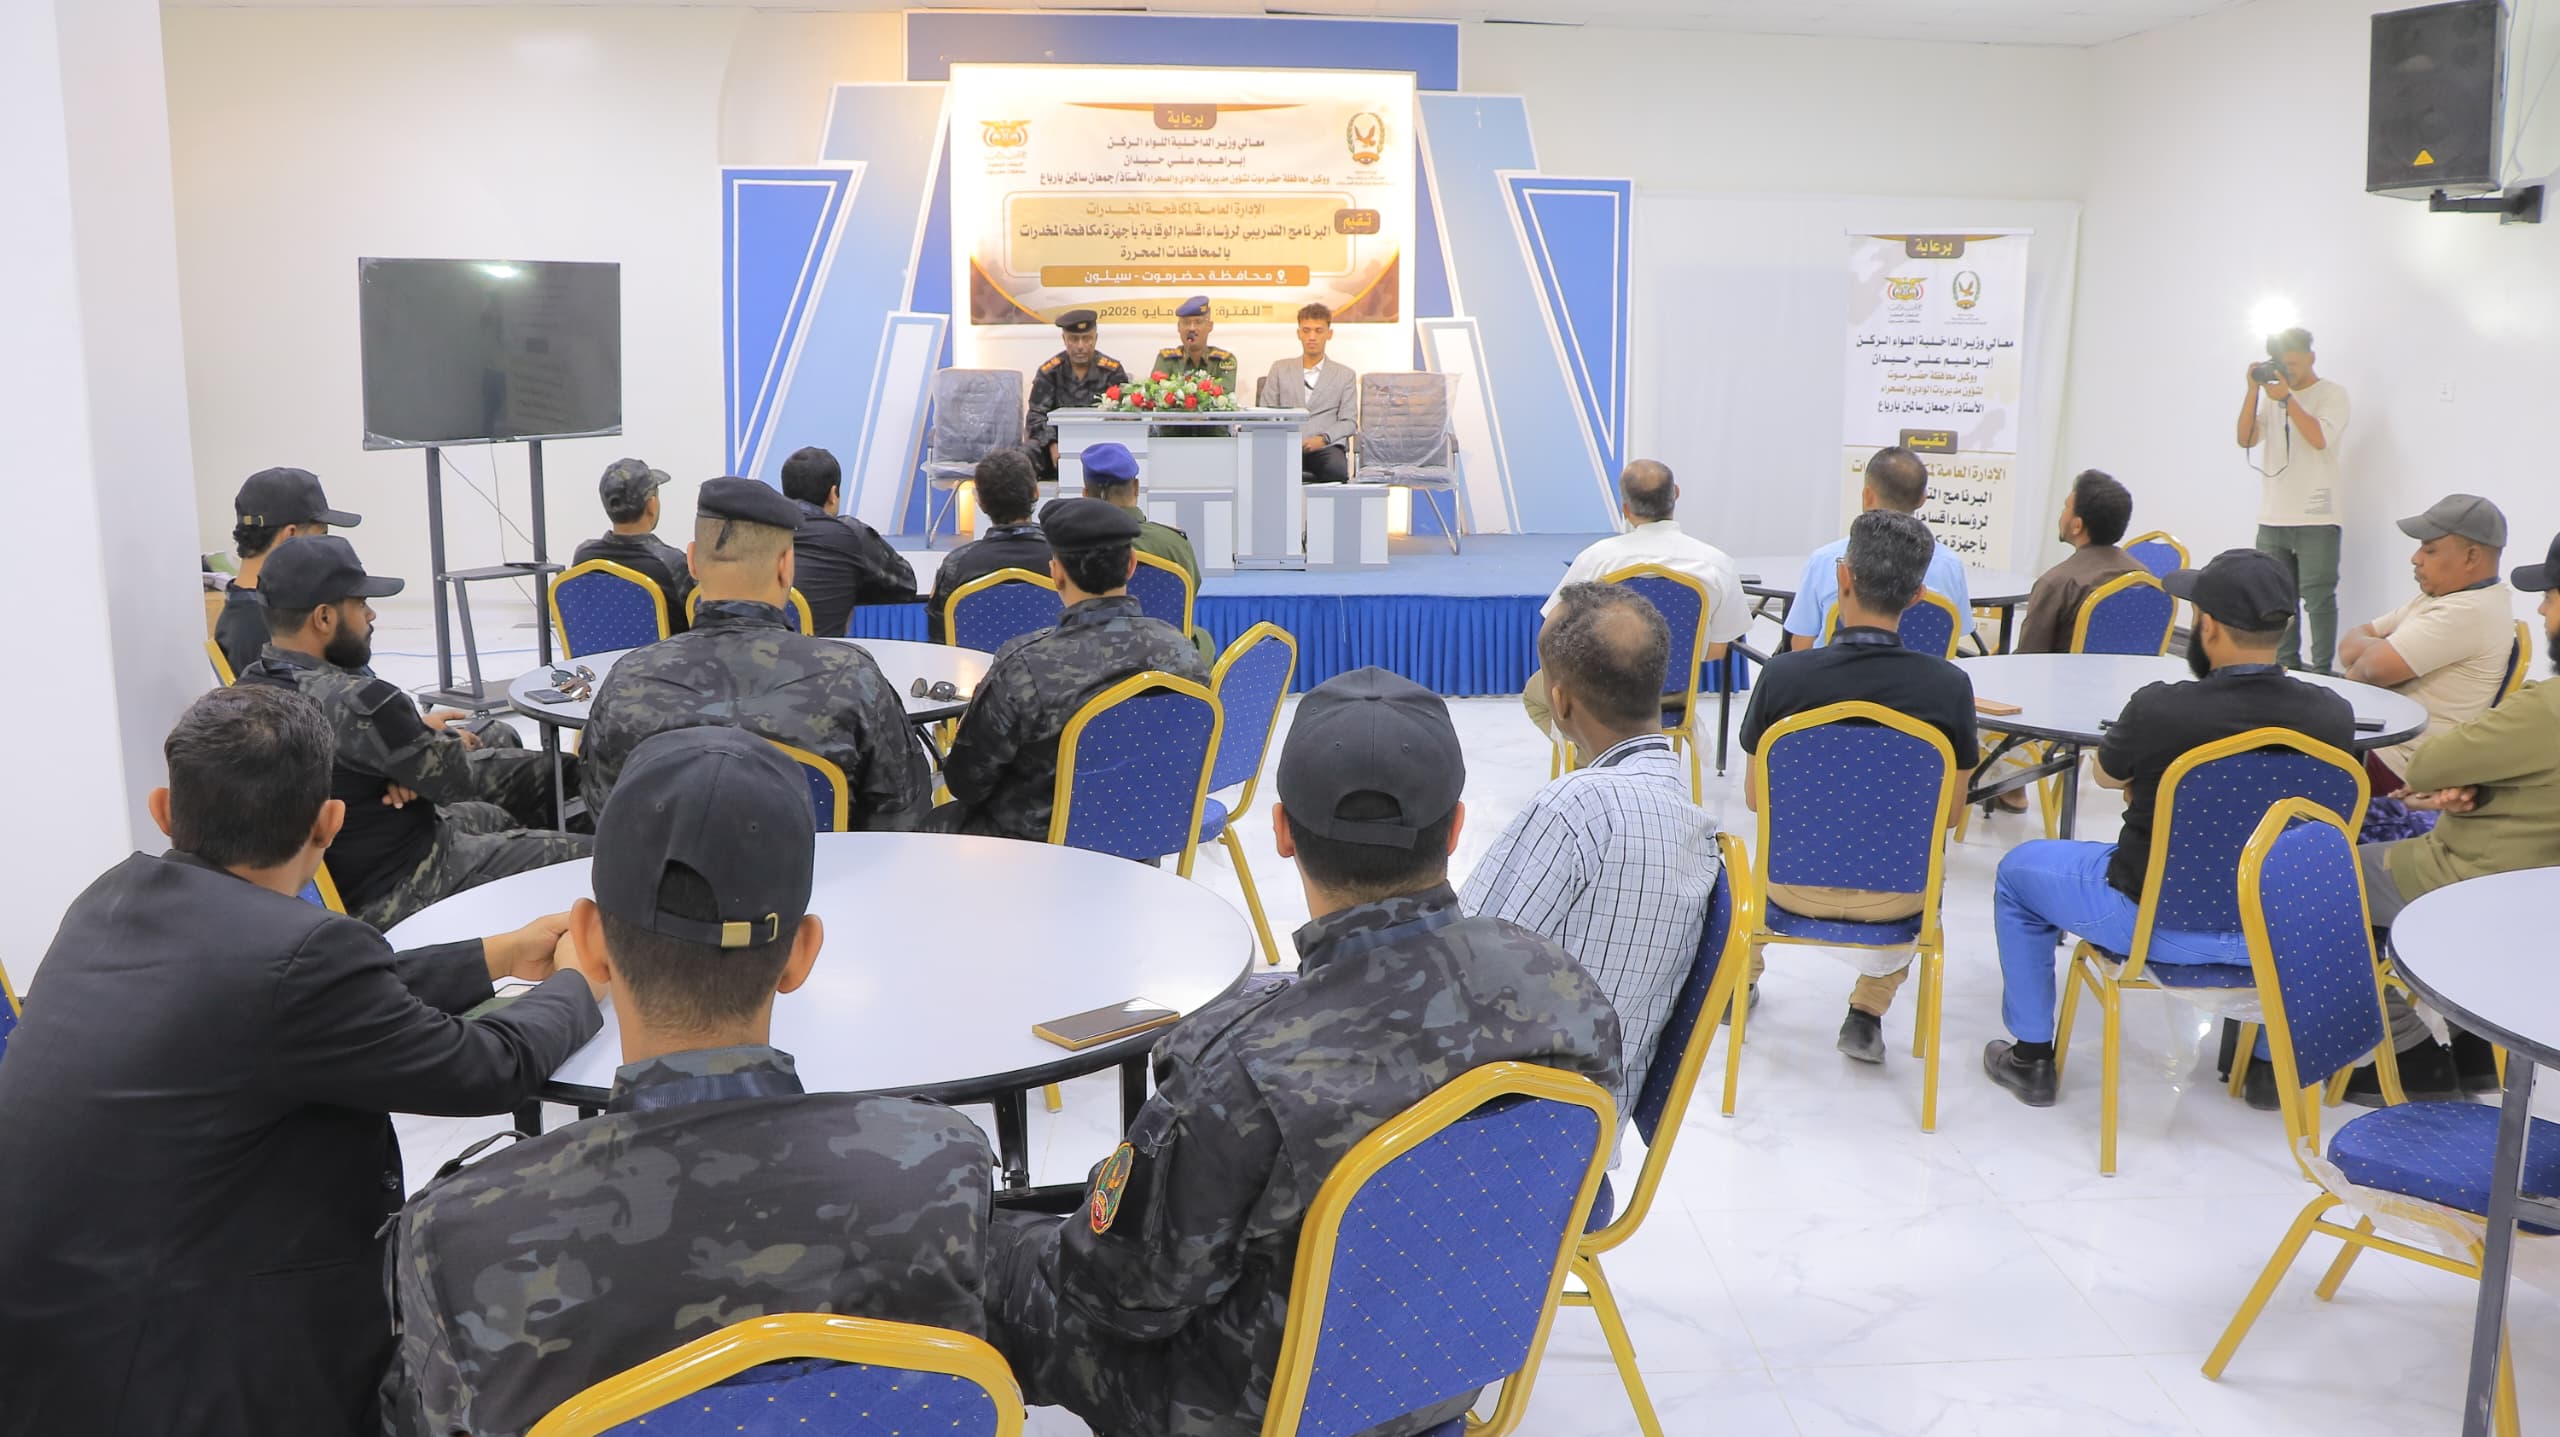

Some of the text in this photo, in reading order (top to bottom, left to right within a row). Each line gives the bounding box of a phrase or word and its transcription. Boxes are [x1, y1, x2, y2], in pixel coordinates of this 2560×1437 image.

[1167, 110, 1204, 127] برعاية
[1107, 136, 1143, 149] الركن
[1145, 136, 1170, 149] اللواء
[1171, 136, 1215, 148] الداخلية
[1216, 136, 1236, 150] وزير
[1167, 155, 1194, 168] علي
[1087, 201, 1144, 217] المخدرات
[1146, 201, 1191, 215] لمكافحة
[1195, 201, 1233, 215] العامة
[1343, 213, 1372, 229] تقيم
[1020, 223, 1062, 239] المخدرات
[1063, 223, 1101, 237] مكافحة
[1139, 223, 1175, 240] الوقاية
[1243, 225, 1286, 241] التدريبي
[1289, 225, 1331, 240] البرنامج
[1120, 245, 1231, 261] بالمحافظات المحررة
[1914, 238, 1953, 256] برعاية
[1084, 269, 1132, 284] سيئون
[1142, 270, 1206, 284] حضرموت
[1209, 269, 1273, 282] محافظة
[1142, 305, 1174, 318] مايو
[1215, 305, 1260, 318] للفترة:
[1856, 334, 2014, 351] معالي وزير الداخلية اللواء الركن
[1872, 352, 1911, 365] حيدان
[1914, 354, 1941, 368] علي
[1907, 432, 1948, 448] تقيم
[1937, 463, 1971, 478] العامة
[1971, 465, 2006, 484] الإدارة
[1943, 488, 1992, 506] البرنامج
[1951, 513, 1989, 530] لرؤساء
